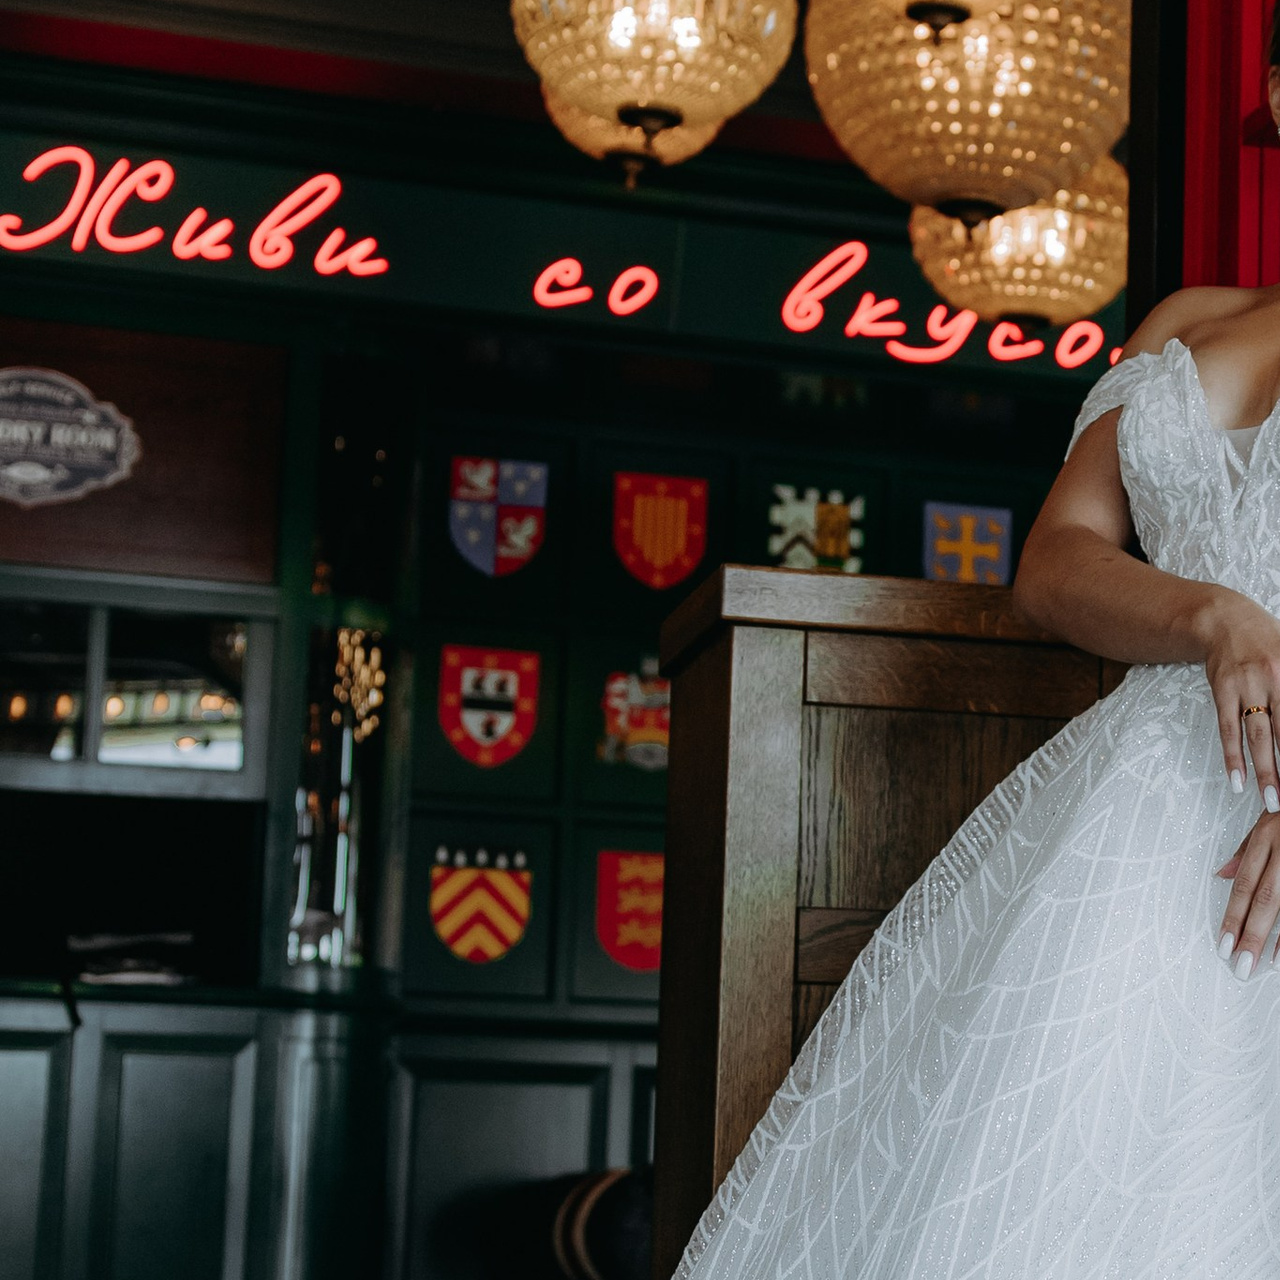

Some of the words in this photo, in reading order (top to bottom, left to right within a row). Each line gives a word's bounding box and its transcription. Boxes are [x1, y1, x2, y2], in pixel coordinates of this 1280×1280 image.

[0, 145, 390, 278] Живи
[532, 256, 660, 317] со
[780, 240, 1124, 370] вкусо
